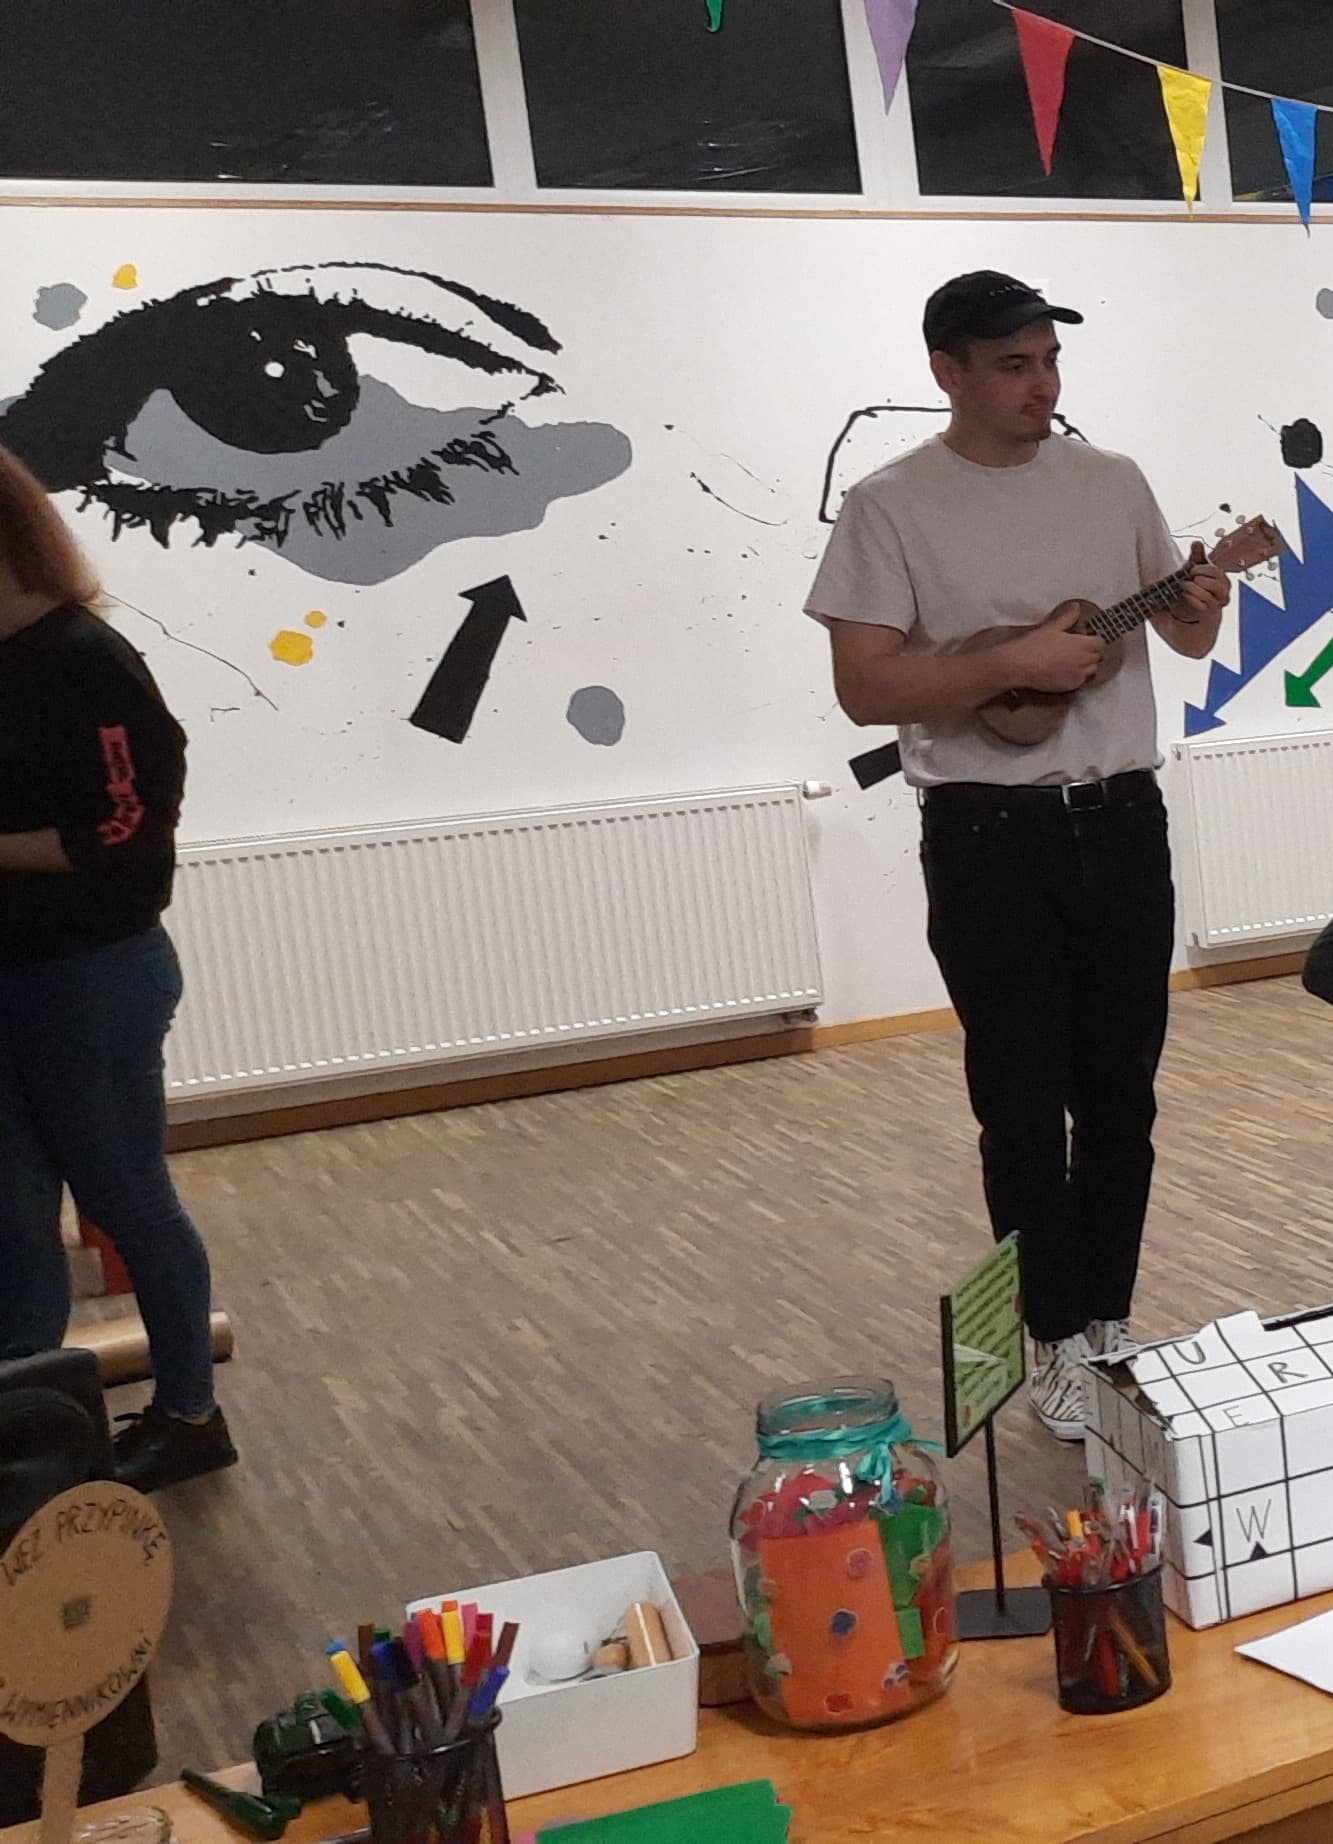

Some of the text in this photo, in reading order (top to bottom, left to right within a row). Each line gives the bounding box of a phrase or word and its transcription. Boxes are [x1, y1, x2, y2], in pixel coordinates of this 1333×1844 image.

[1267, 1360, 1309, 1385] R
[1223, 1404, 1251, 1429] E
[1234, 1498, 1273, 1544] W
